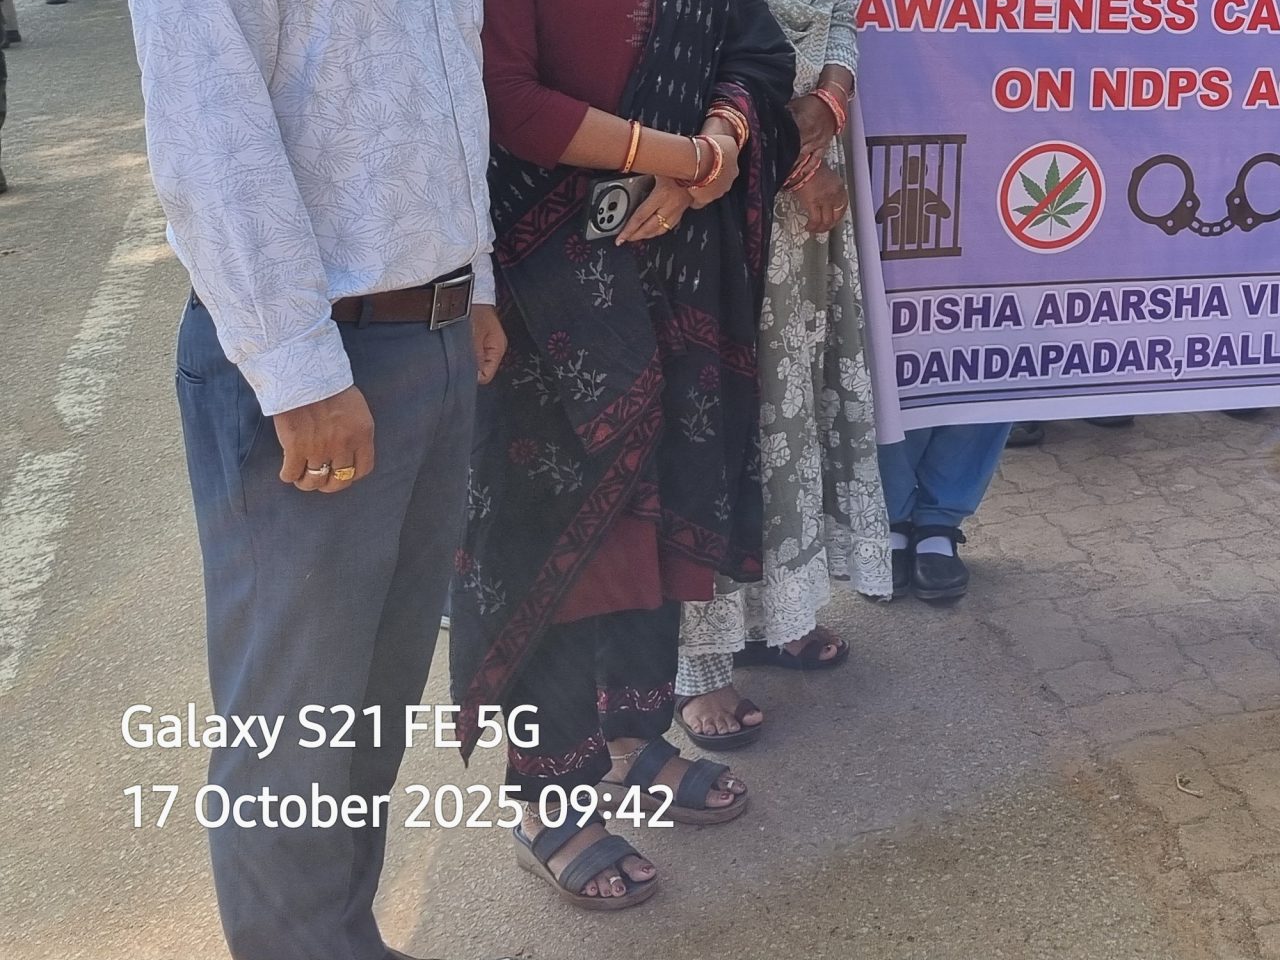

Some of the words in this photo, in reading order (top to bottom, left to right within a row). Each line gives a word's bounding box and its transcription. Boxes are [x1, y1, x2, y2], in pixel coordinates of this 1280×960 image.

[993, 69, 1074, 110] ON
[1091, 68, 1231, 109] NDPS
[891, 294, 1023, 335] DISHA
[1034, 285, 1229, 326] ADARSHA
